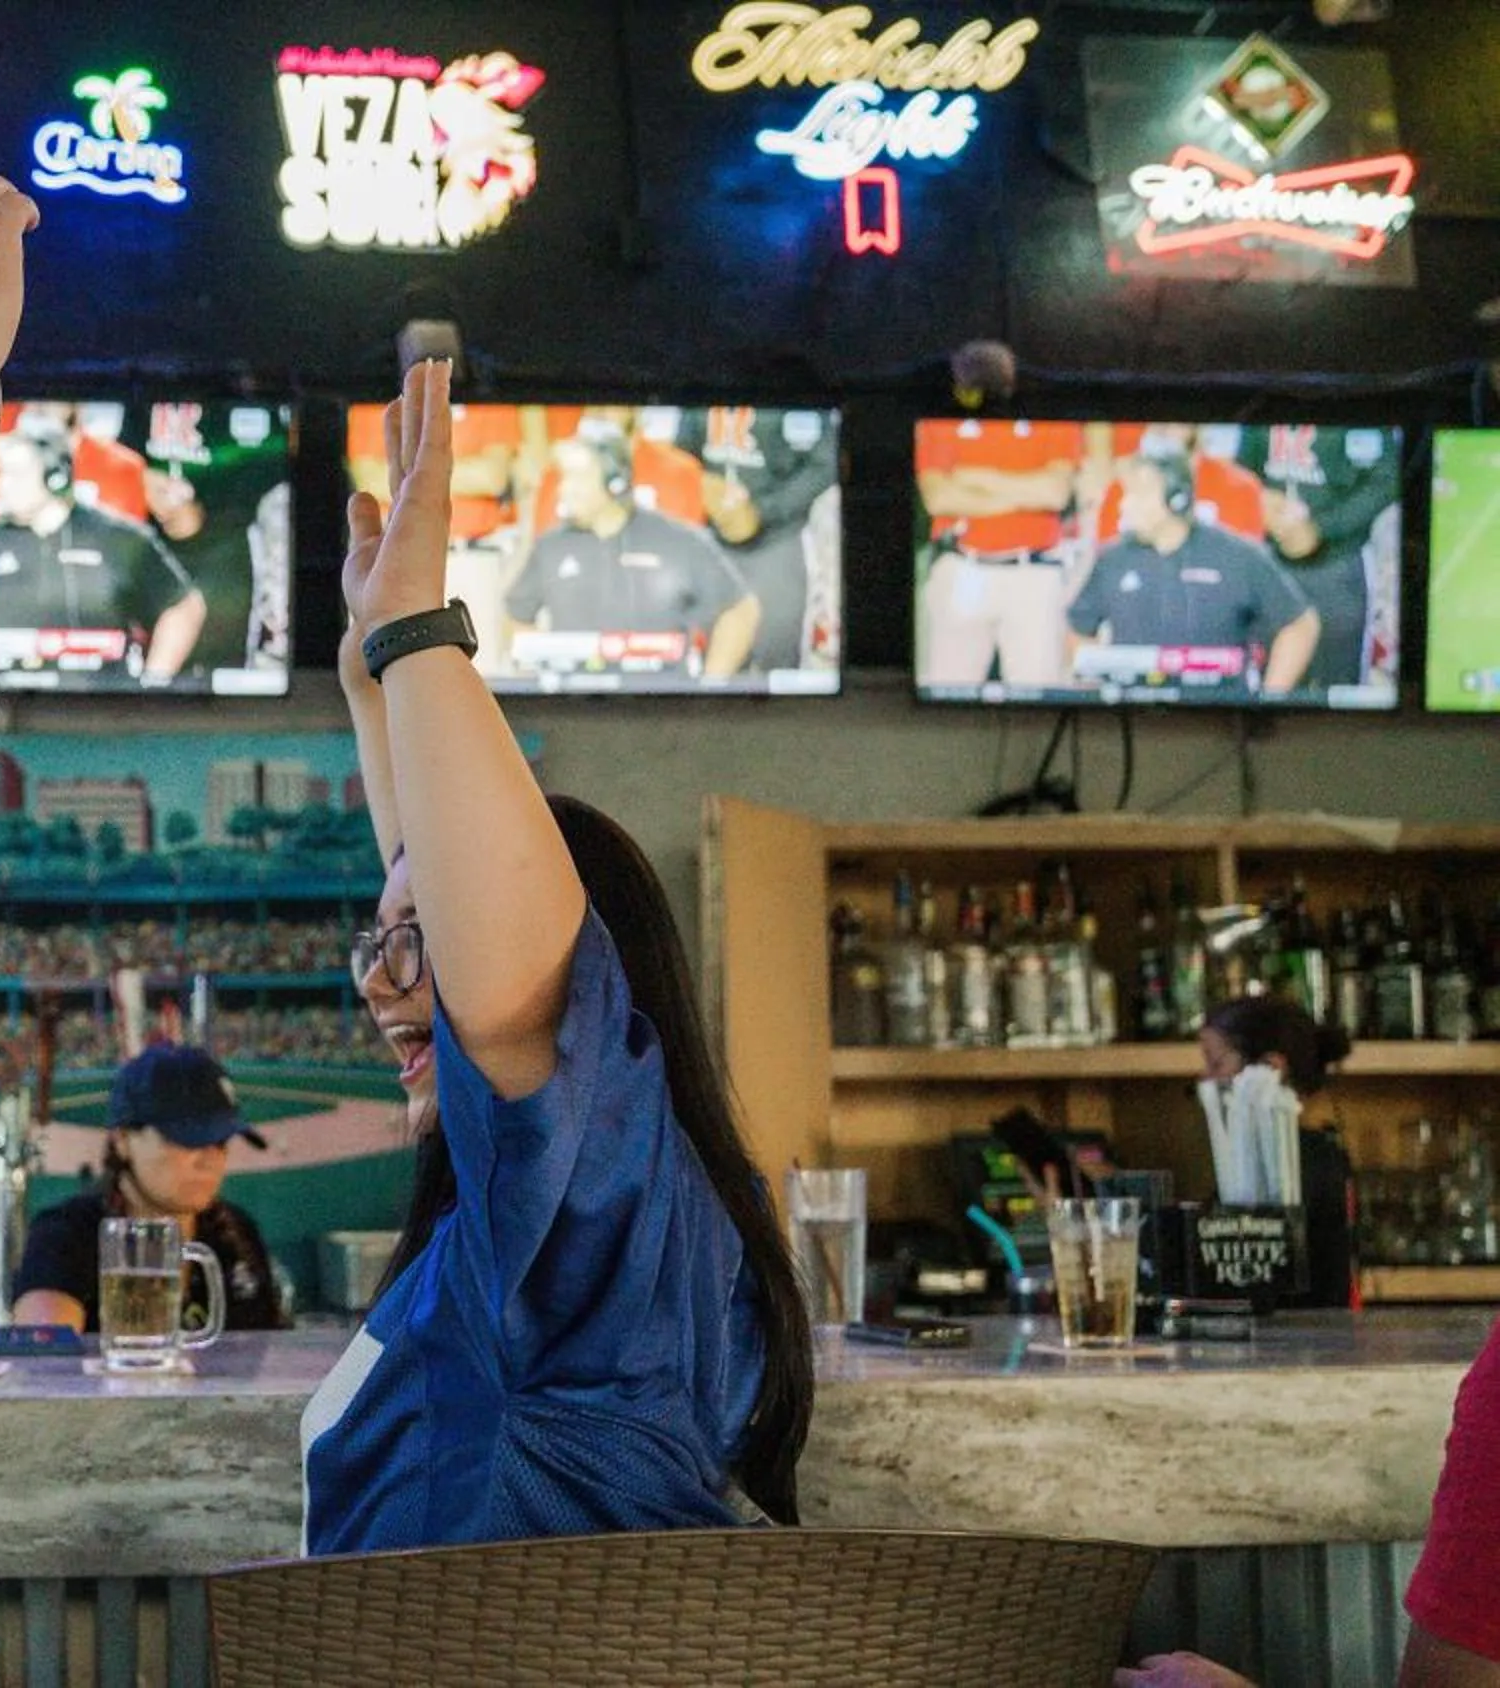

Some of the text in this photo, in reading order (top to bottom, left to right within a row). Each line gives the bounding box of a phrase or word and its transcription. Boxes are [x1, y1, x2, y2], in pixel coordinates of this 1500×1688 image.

[691, 2, 1040, 91] Michelob
[33, 120, 184, 183] Corona
[755, 80, 980, 181] Light
